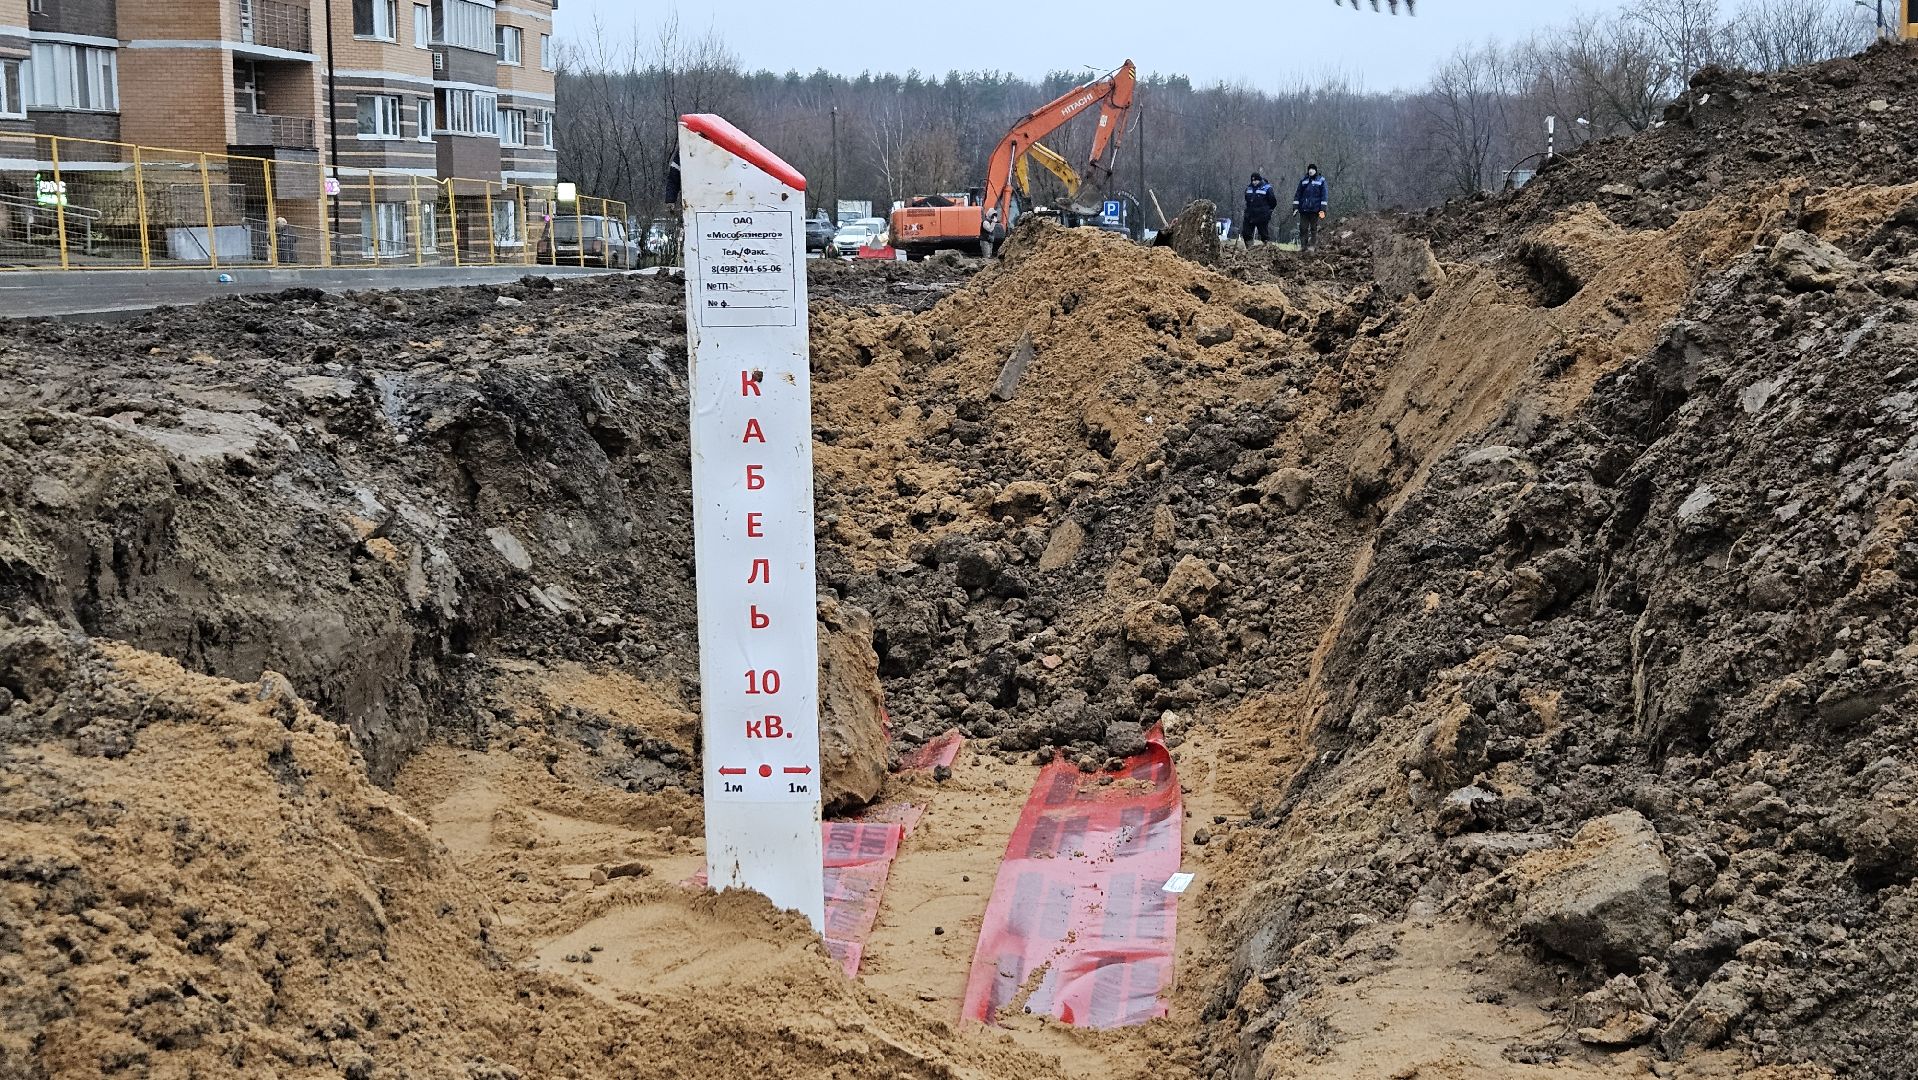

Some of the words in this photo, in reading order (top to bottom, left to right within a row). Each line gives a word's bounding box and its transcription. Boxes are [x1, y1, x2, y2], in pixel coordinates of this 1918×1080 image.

[1061, 93, 1094, 116] HITACHI
[733, 217, 753, 225] ОАО
[711, 265, 782, 274] 8(498)744-65-06
[741, 370, 771, 629] КАБЕЛЬ
[744, 669, 781, 695] 10
[746, 715, 793, 739] кВ.
[724, 782, 743, 792] 1м
[788, 783, 808, 793] 1м
